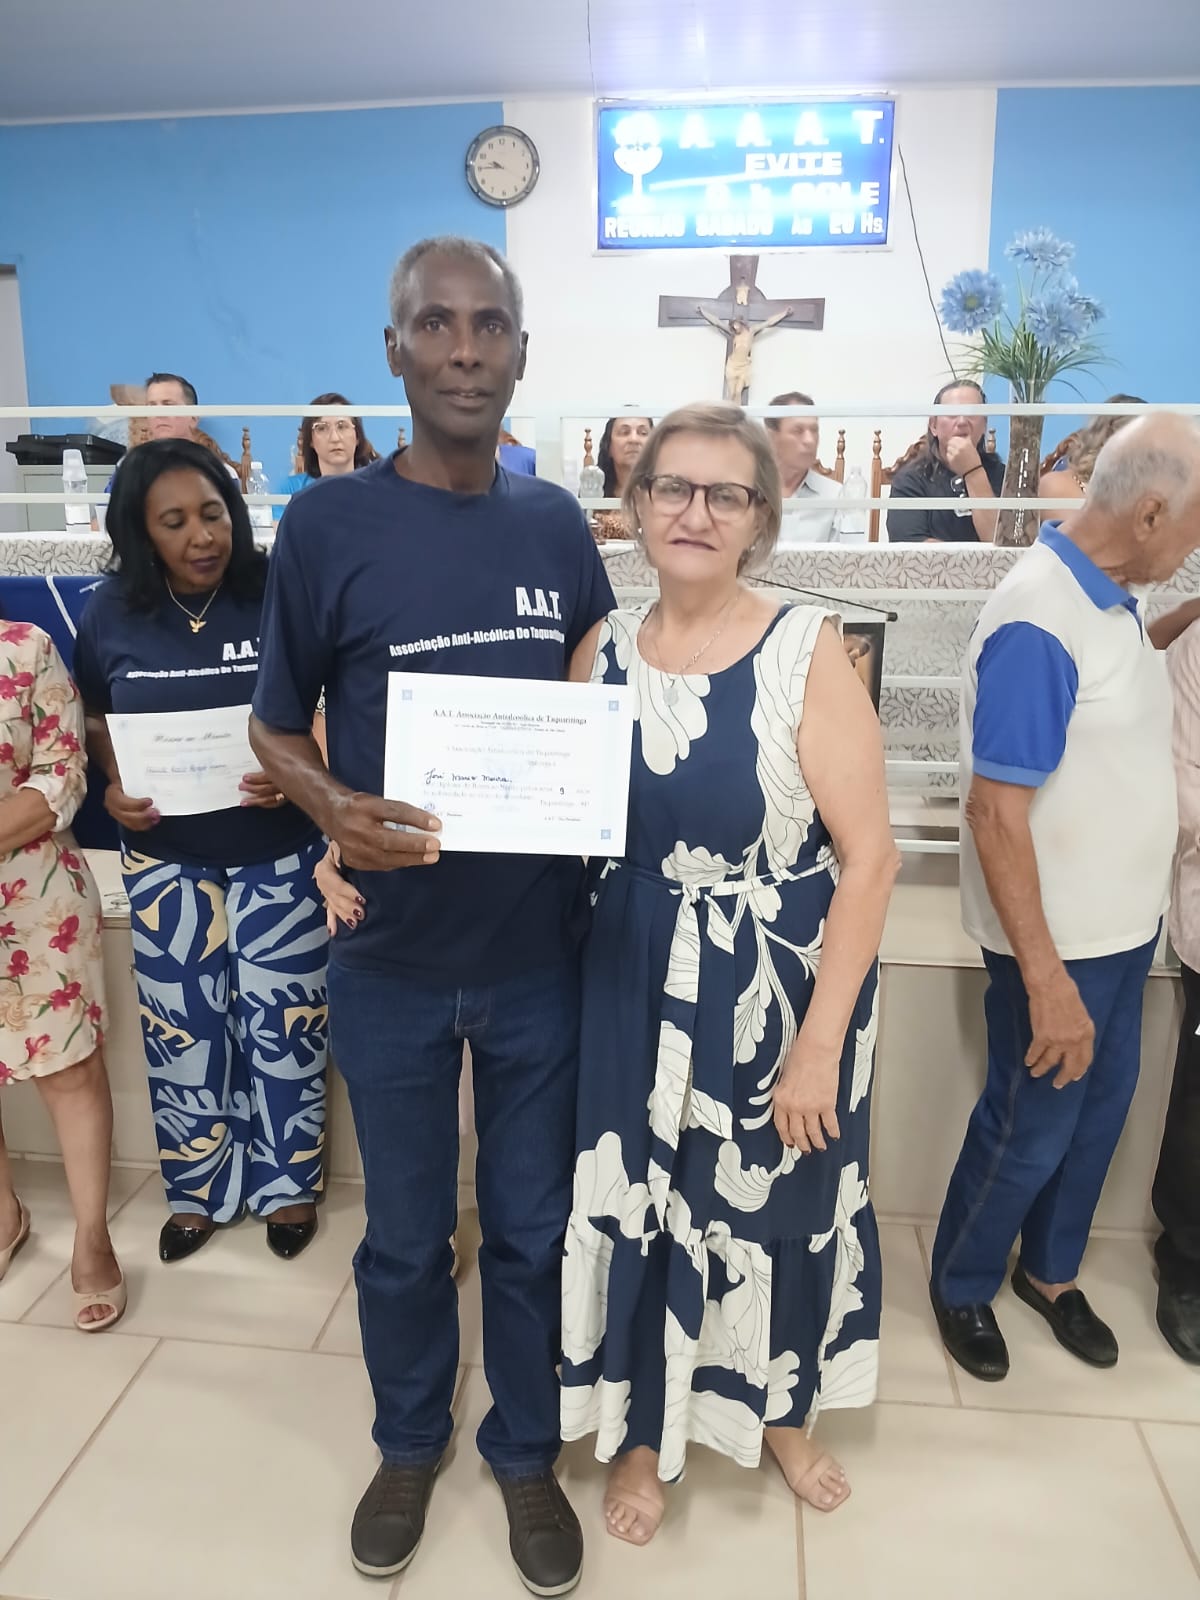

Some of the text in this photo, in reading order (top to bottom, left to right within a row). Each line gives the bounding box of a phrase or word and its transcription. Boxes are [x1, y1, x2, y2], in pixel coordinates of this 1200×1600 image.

[745, 152, 843, 176] EVITE
[515, 586, 562, 621] A.A.T.
[389, 635, 451, 657] Associação
